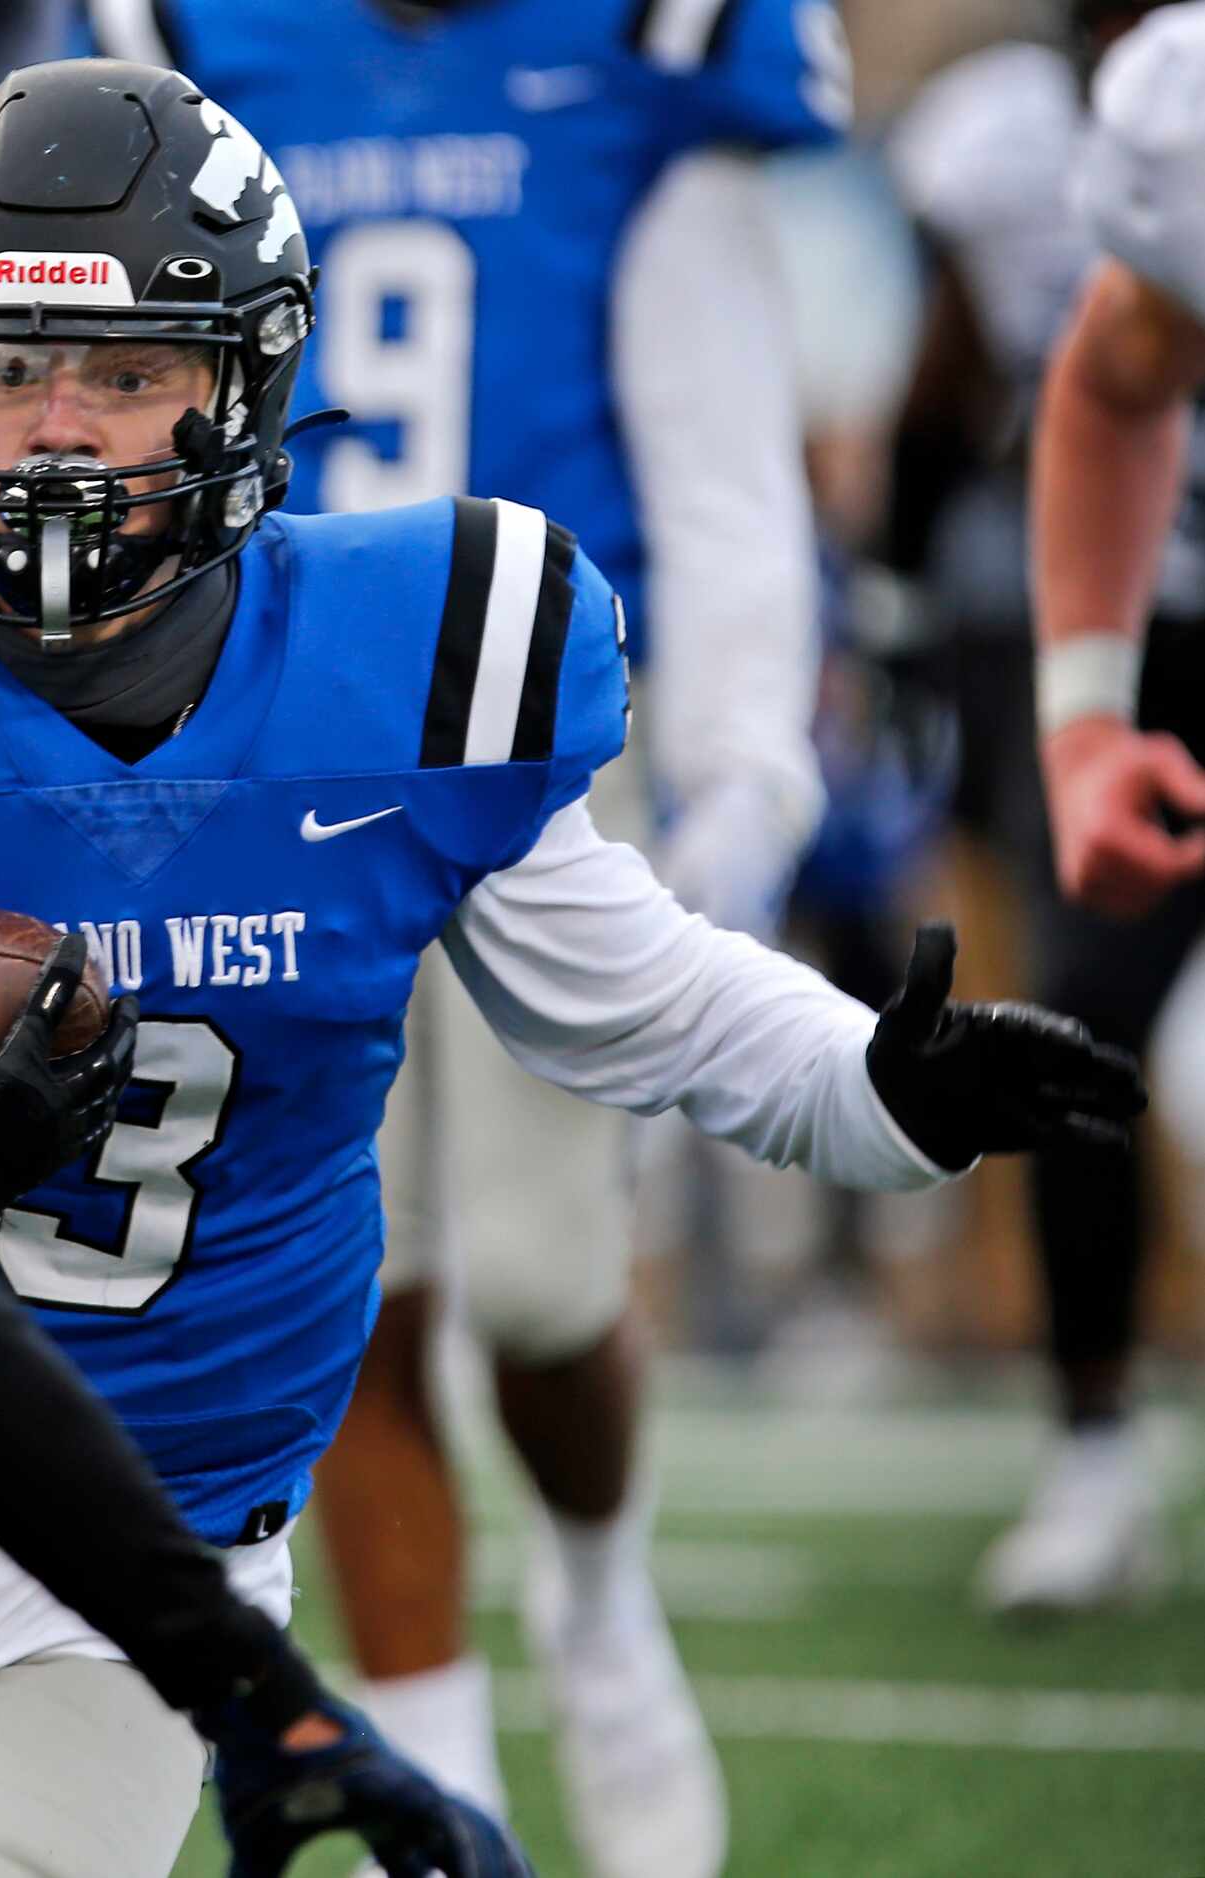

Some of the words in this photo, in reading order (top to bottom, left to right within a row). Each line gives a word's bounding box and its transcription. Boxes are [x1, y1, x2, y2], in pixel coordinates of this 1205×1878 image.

[318, 226, 478, 512] 9
[165, 911, 306, 987] WEST
[257, 1512, 270, 1538] L
